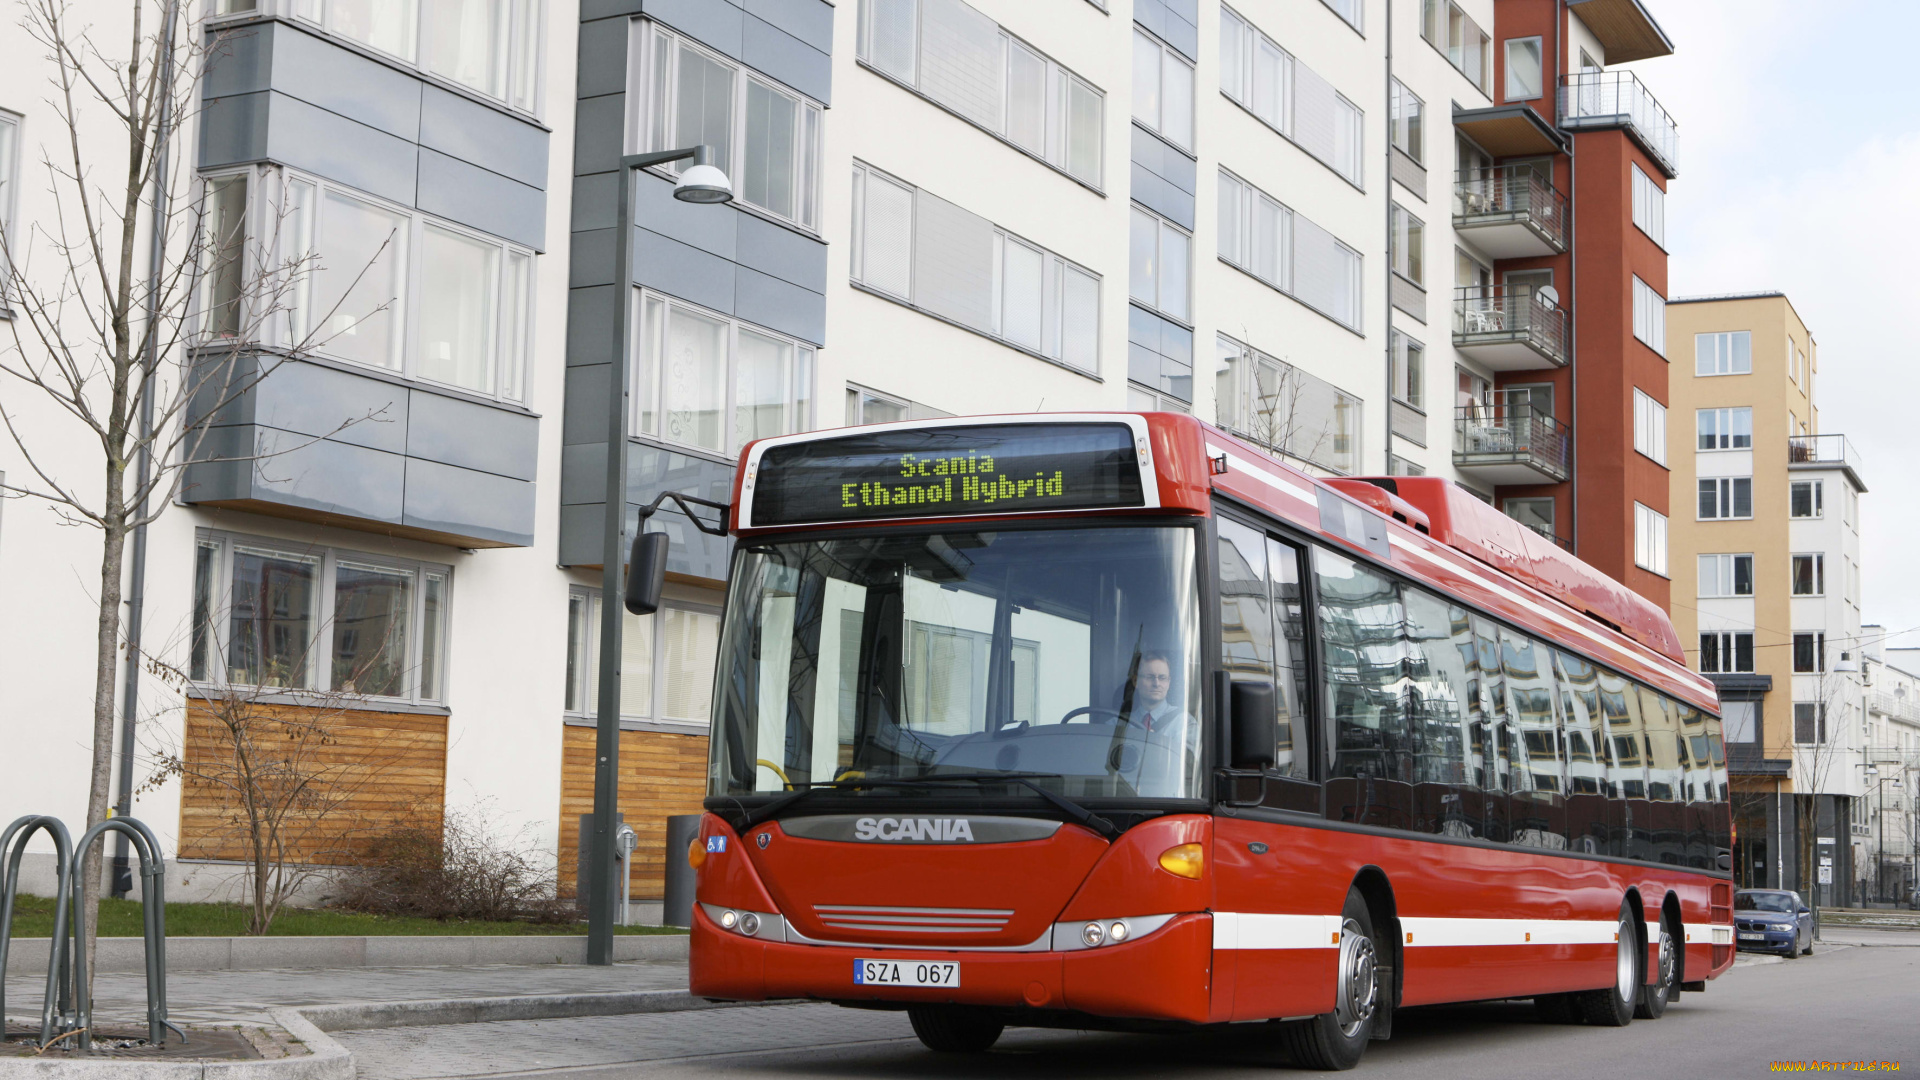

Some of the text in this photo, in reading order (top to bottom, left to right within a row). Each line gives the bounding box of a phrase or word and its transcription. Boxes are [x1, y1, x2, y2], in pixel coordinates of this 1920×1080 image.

[900, 449, 994, 477] Scania
[842, 470, 1062, 507] Ethanol Hybrid
[855, 817, 974, 842] SCANIA
[866, 962, 954, 984] SZA 067
